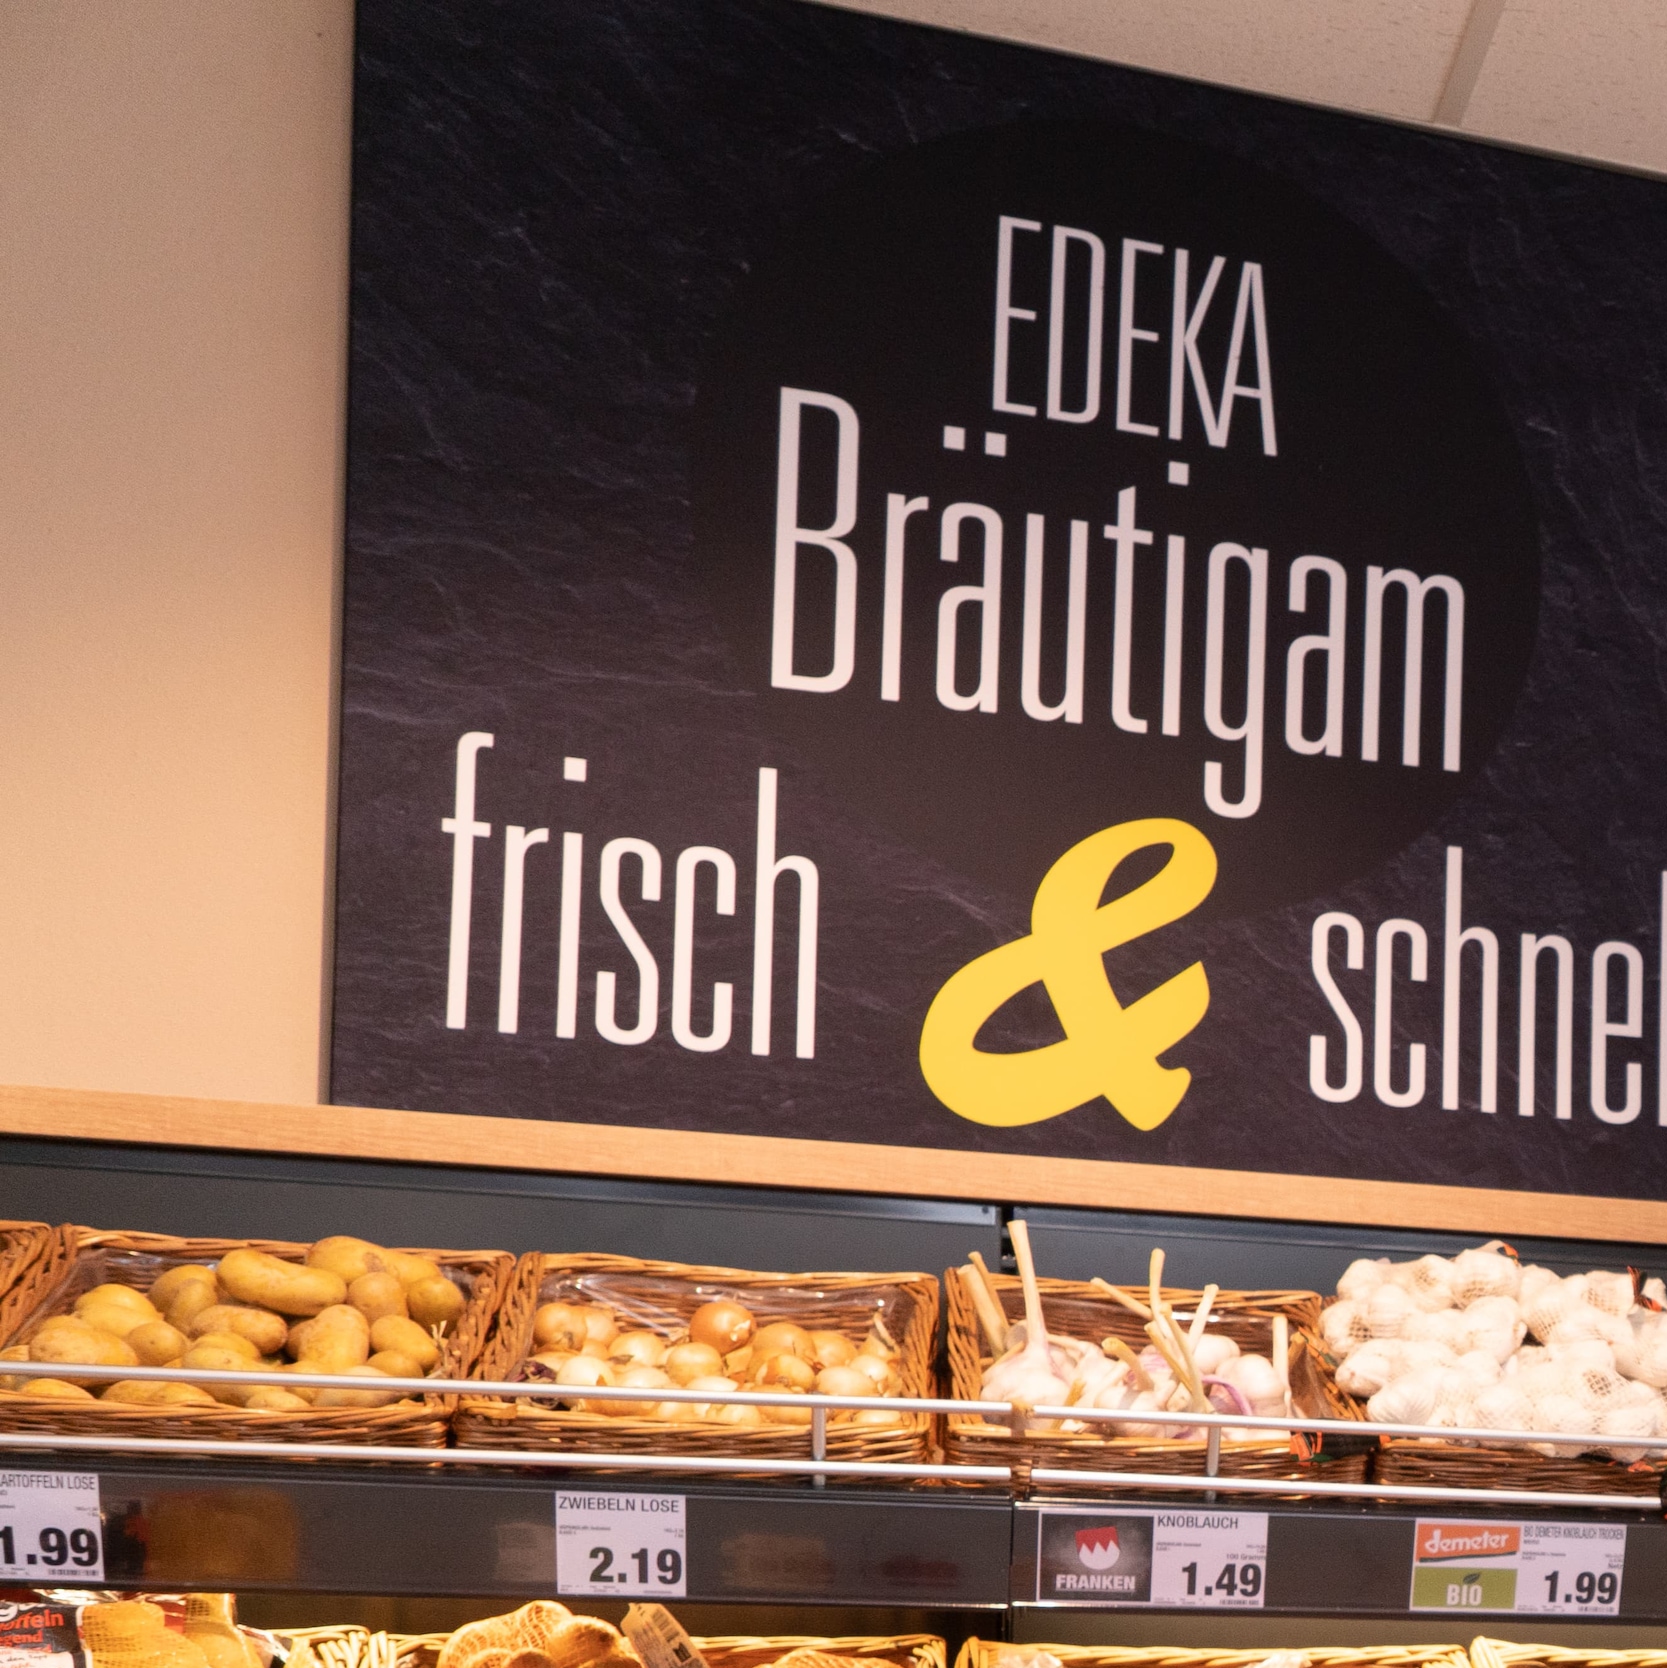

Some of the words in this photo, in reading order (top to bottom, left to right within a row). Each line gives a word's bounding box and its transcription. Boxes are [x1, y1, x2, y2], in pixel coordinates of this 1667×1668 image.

[991, 216, 1277, 456] EDEKA
[769, 387, 1467, 818] Bräutigam
[440, 731, 819, 1059] frisch
[919, 817, 1218, 1131] &
[67, 1476, 96, 1490] LOSE
[559, 1496, 635, 1511] ZWIEBELN
[641, 1500, 680, 1513] LOSE
[1157, 1516, 1239, 1529] KNOBLAUCH
[0, 1526, 98, 1566] 1.99
[1424, 1529, 1510, 1554] demeter
[589, 1547, 682, 1584] 2.19
[1055, 1574, 1136, 1590] FRANKEN
[1182, 1562, 1262, 1597] 1.49
[1447, 1584, 1482, 1606] BIO
[1545, 1570, 1618, 1605] 1.99
